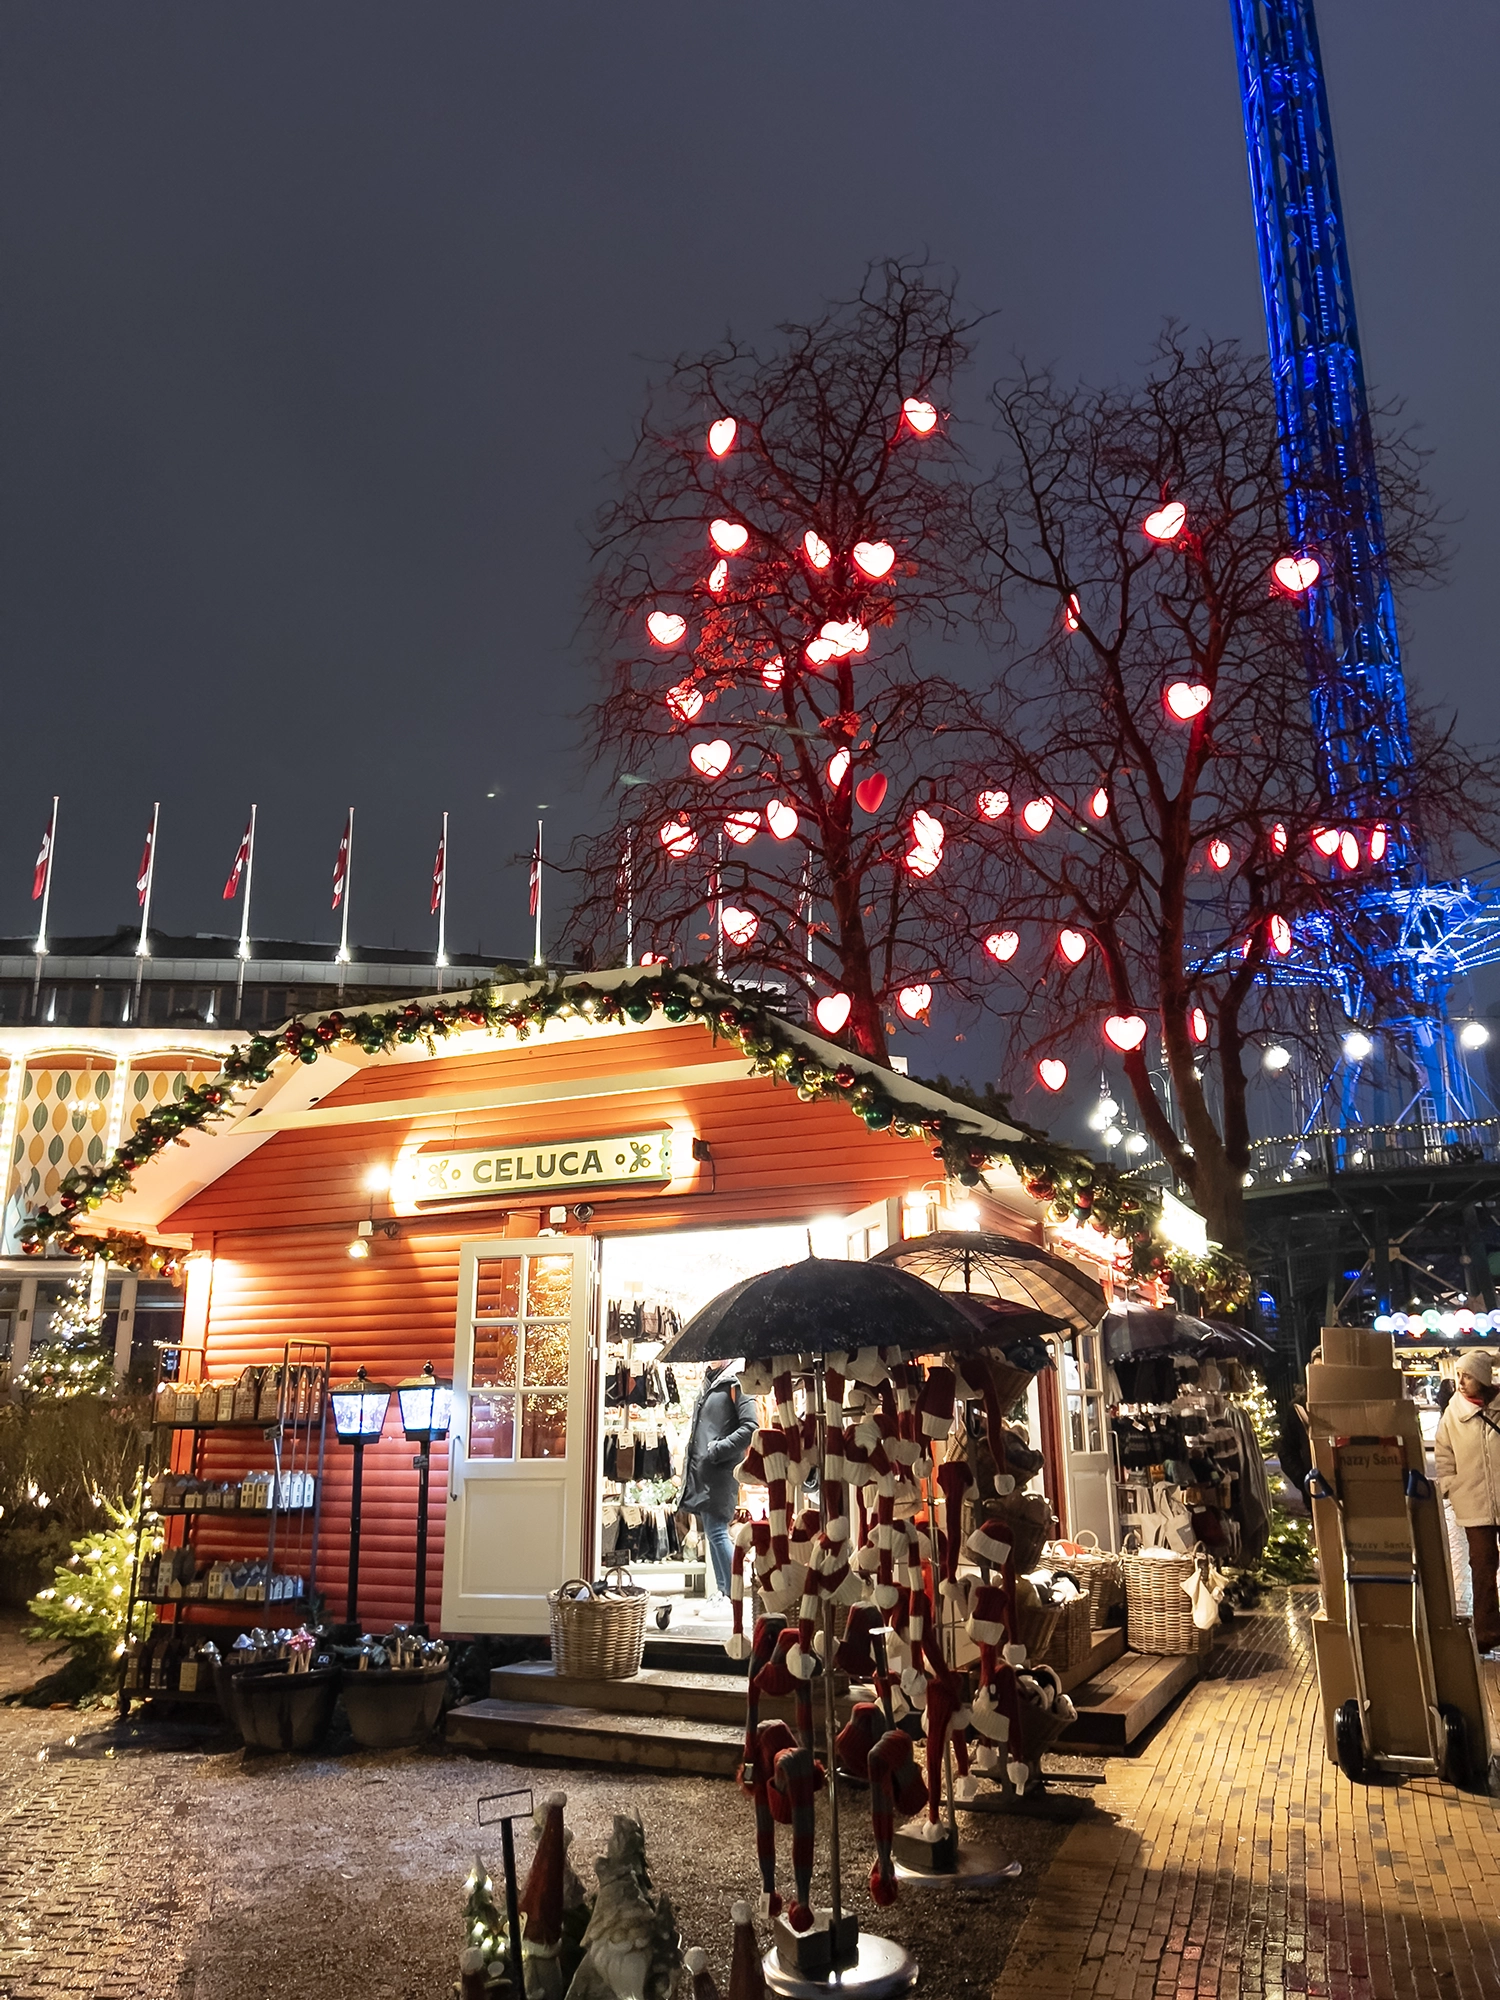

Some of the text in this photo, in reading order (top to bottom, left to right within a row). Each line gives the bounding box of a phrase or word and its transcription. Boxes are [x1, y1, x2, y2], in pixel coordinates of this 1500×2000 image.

[473, 1150, 603, 1183] CELUCA
[1338, 1452, 1400, 1469] nazzy Sant
